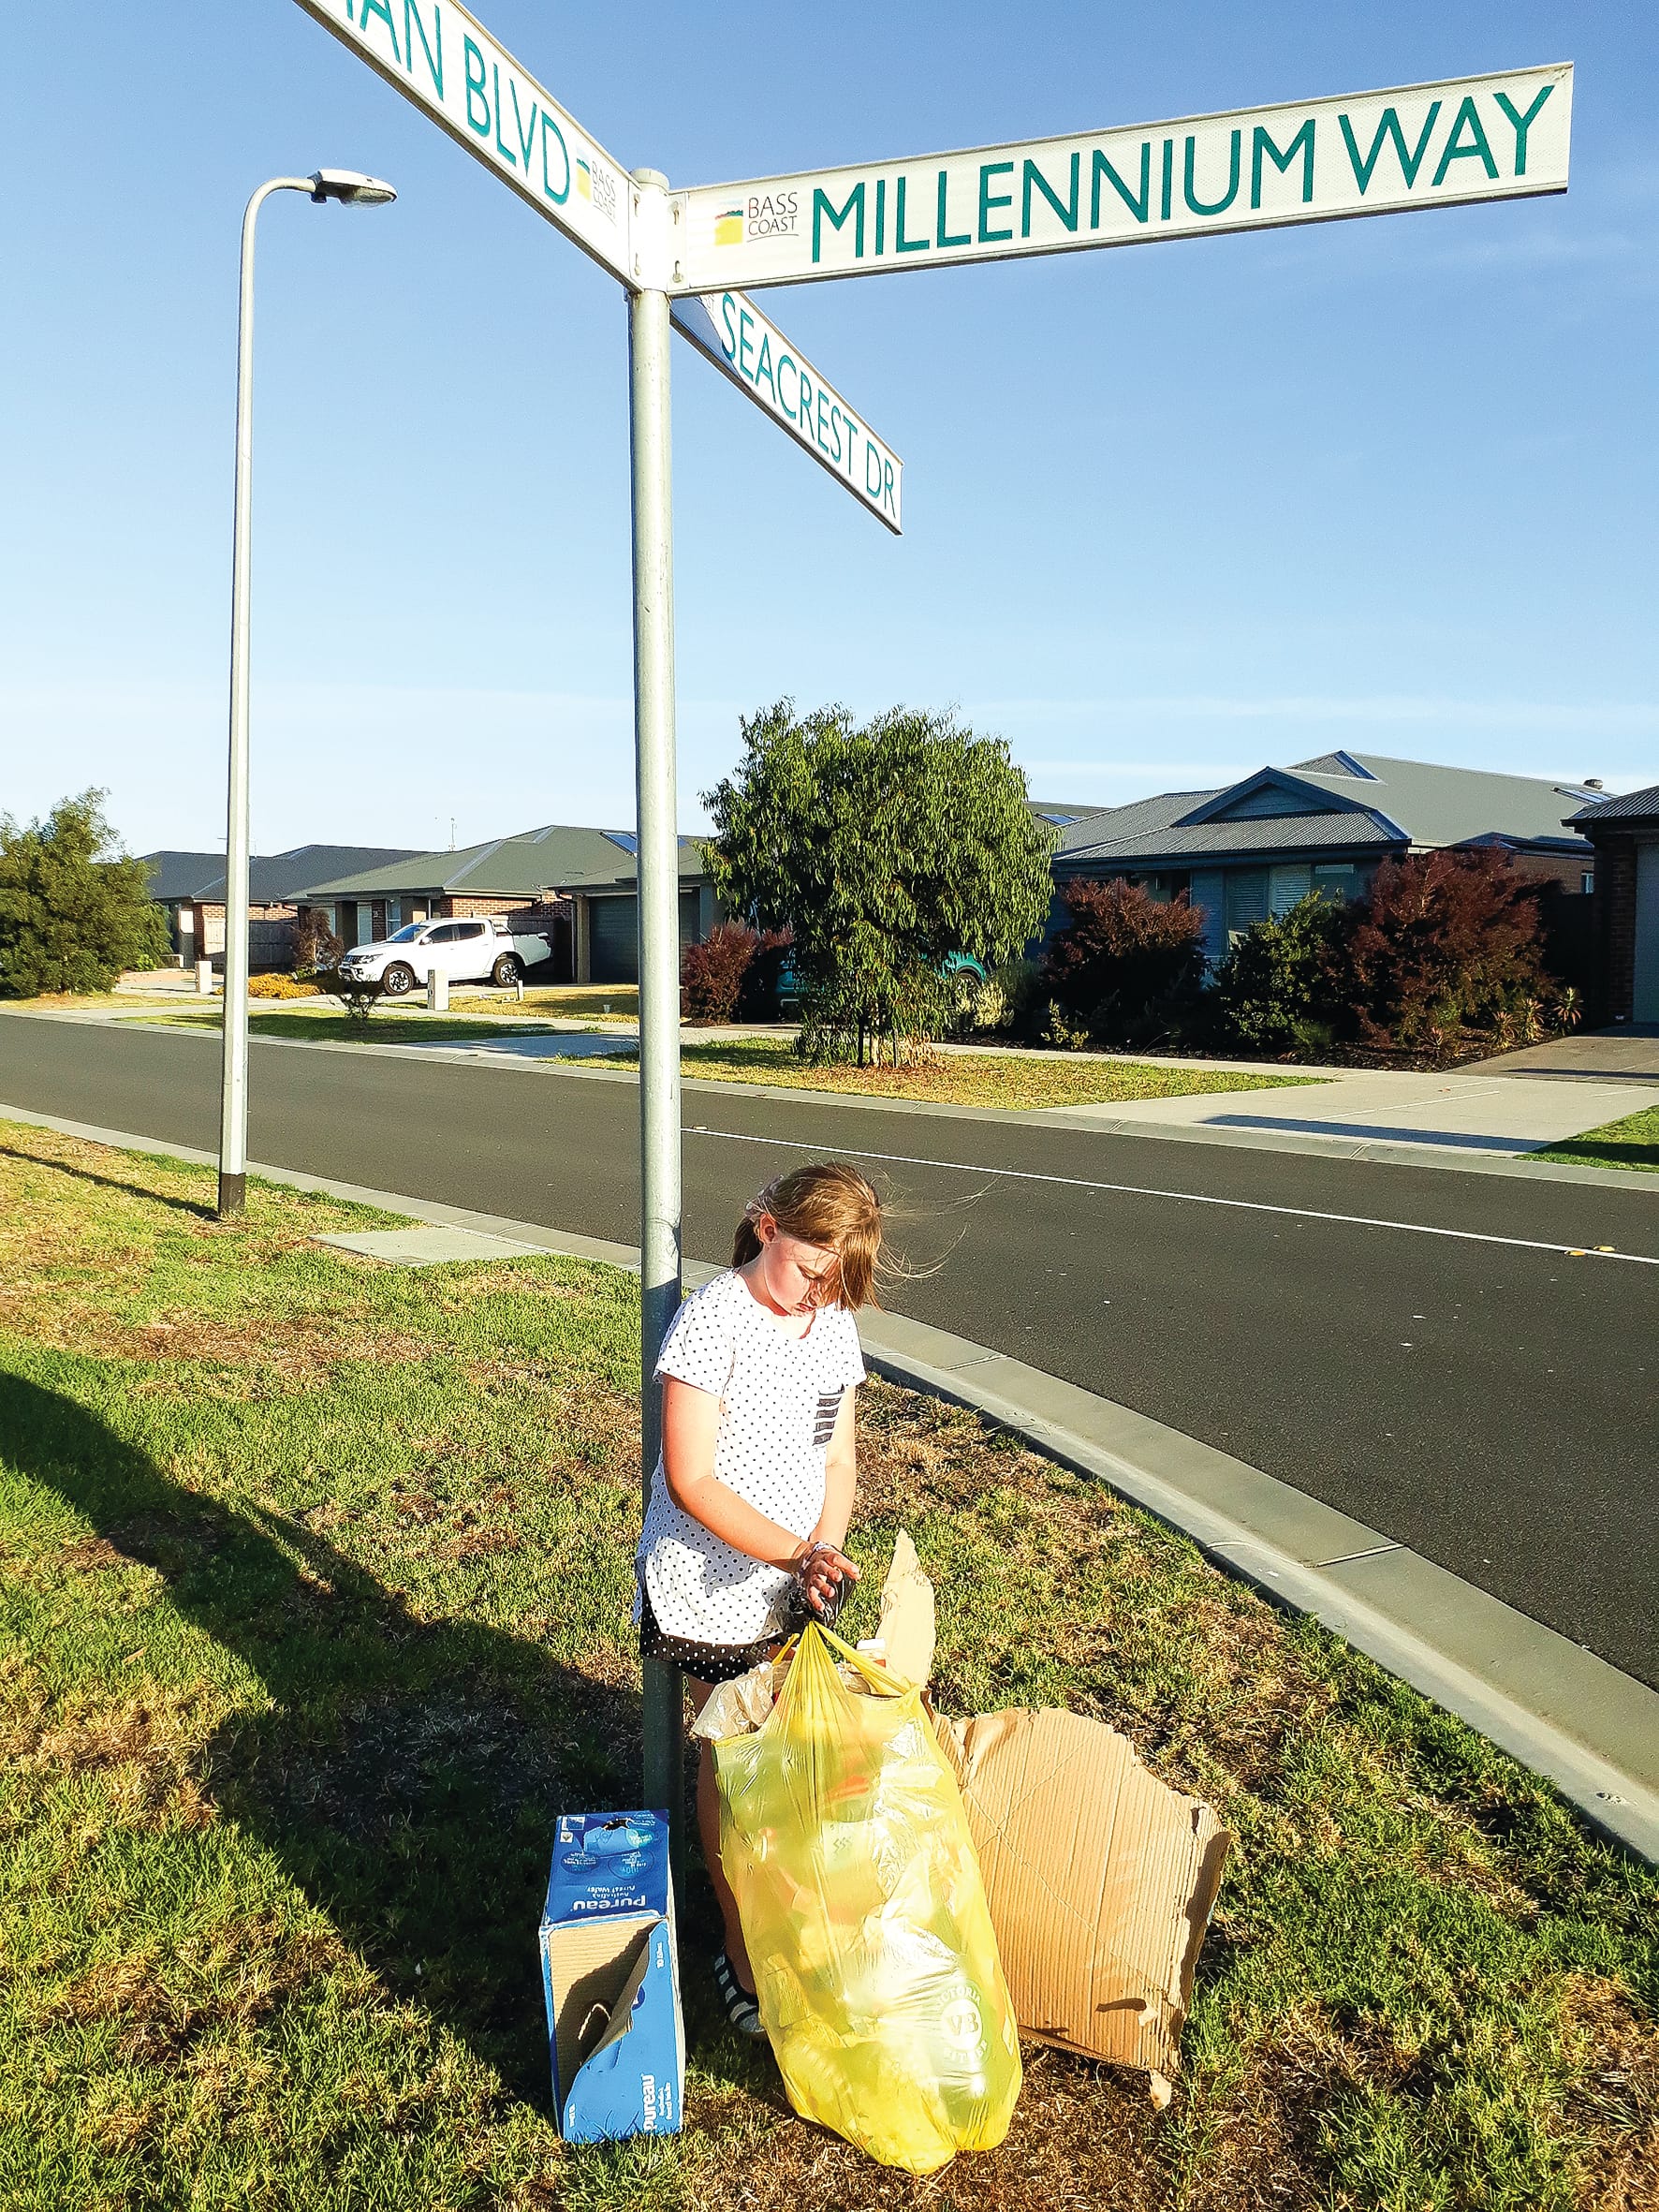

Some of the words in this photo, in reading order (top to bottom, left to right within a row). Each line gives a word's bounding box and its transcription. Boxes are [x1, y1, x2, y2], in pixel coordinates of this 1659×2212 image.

[345, 0, 444, 101] AN
[463, 33, 570, 205] BLVD
[592, 160, 616, 201] BASS
[812, 118, 1315, 263] MILLENNIUM
[1338, 85, 1554, 195] WAY
[748, 192, 798, 218] BASS
[748, 215, 798, 235] COAST
[722, 291, 859, 476] SEACREST
[866, 440, 896, 519] DR
[947, 2013, 979, 2036] VB
